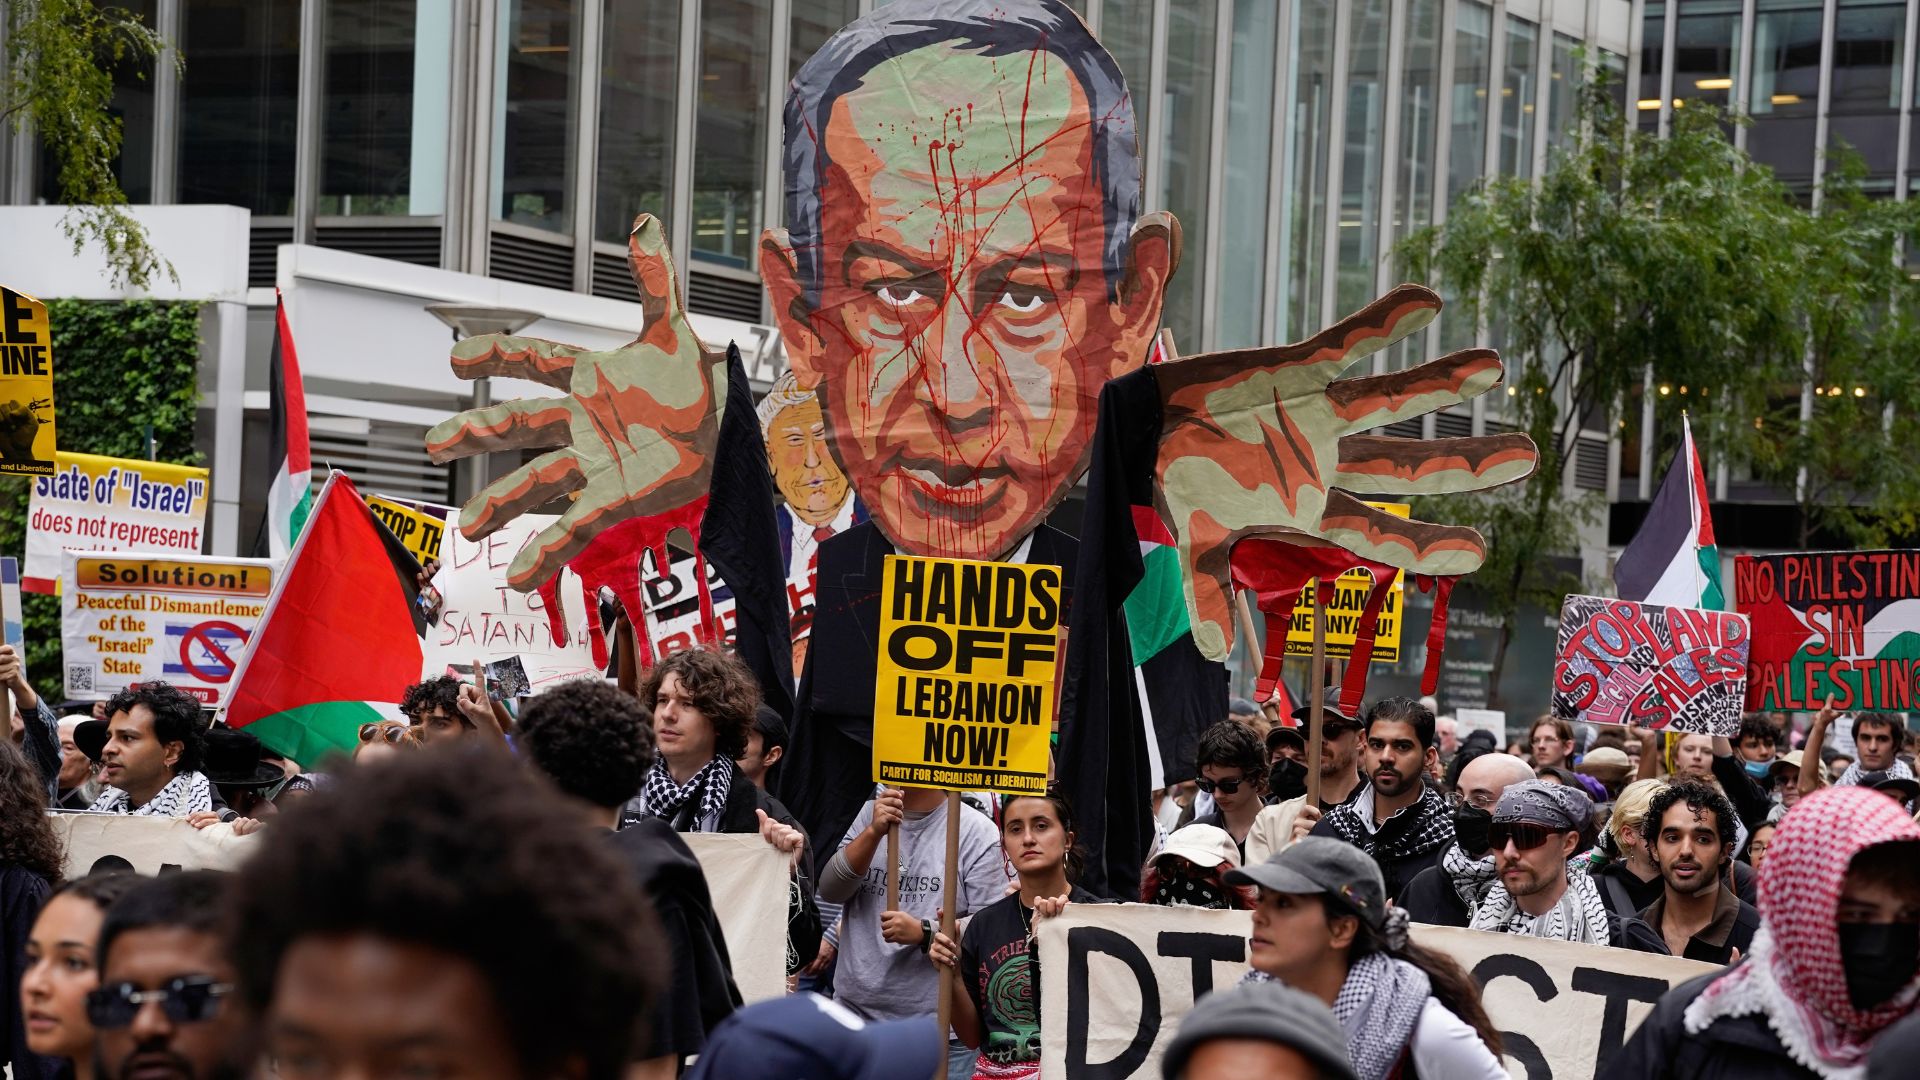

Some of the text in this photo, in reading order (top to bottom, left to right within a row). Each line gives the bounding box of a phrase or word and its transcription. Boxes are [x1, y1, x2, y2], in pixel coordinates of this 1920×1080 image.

[1, 463, 54, 473] and Liberation
[36, 467, 203, 515] State of "Israel"
[32, 507, 200, 551] does not represent
[98, 563, 249, 589] Solution!
[891, 559, 1059, 631] HANDS
[1737, 560, 1775, 604] NO
[76, 592, 146, 612] Peaceful
[99, 615, 145, 632] of the
[888, 624, 1056, 677] OFF
[1635, 606, 1747, 666] LAND
[1805, 604, 1864, 656] SIN
[103, 656, 142, 676] State
[1631, 647, 1746, 729] SALES
[895, 676, 1042, 726] LEBANON
[923, 721, 1010, 768] NOW!
[882, 765, 1046, 790] PARTY FOR SOCIALISM & LIBERATION
